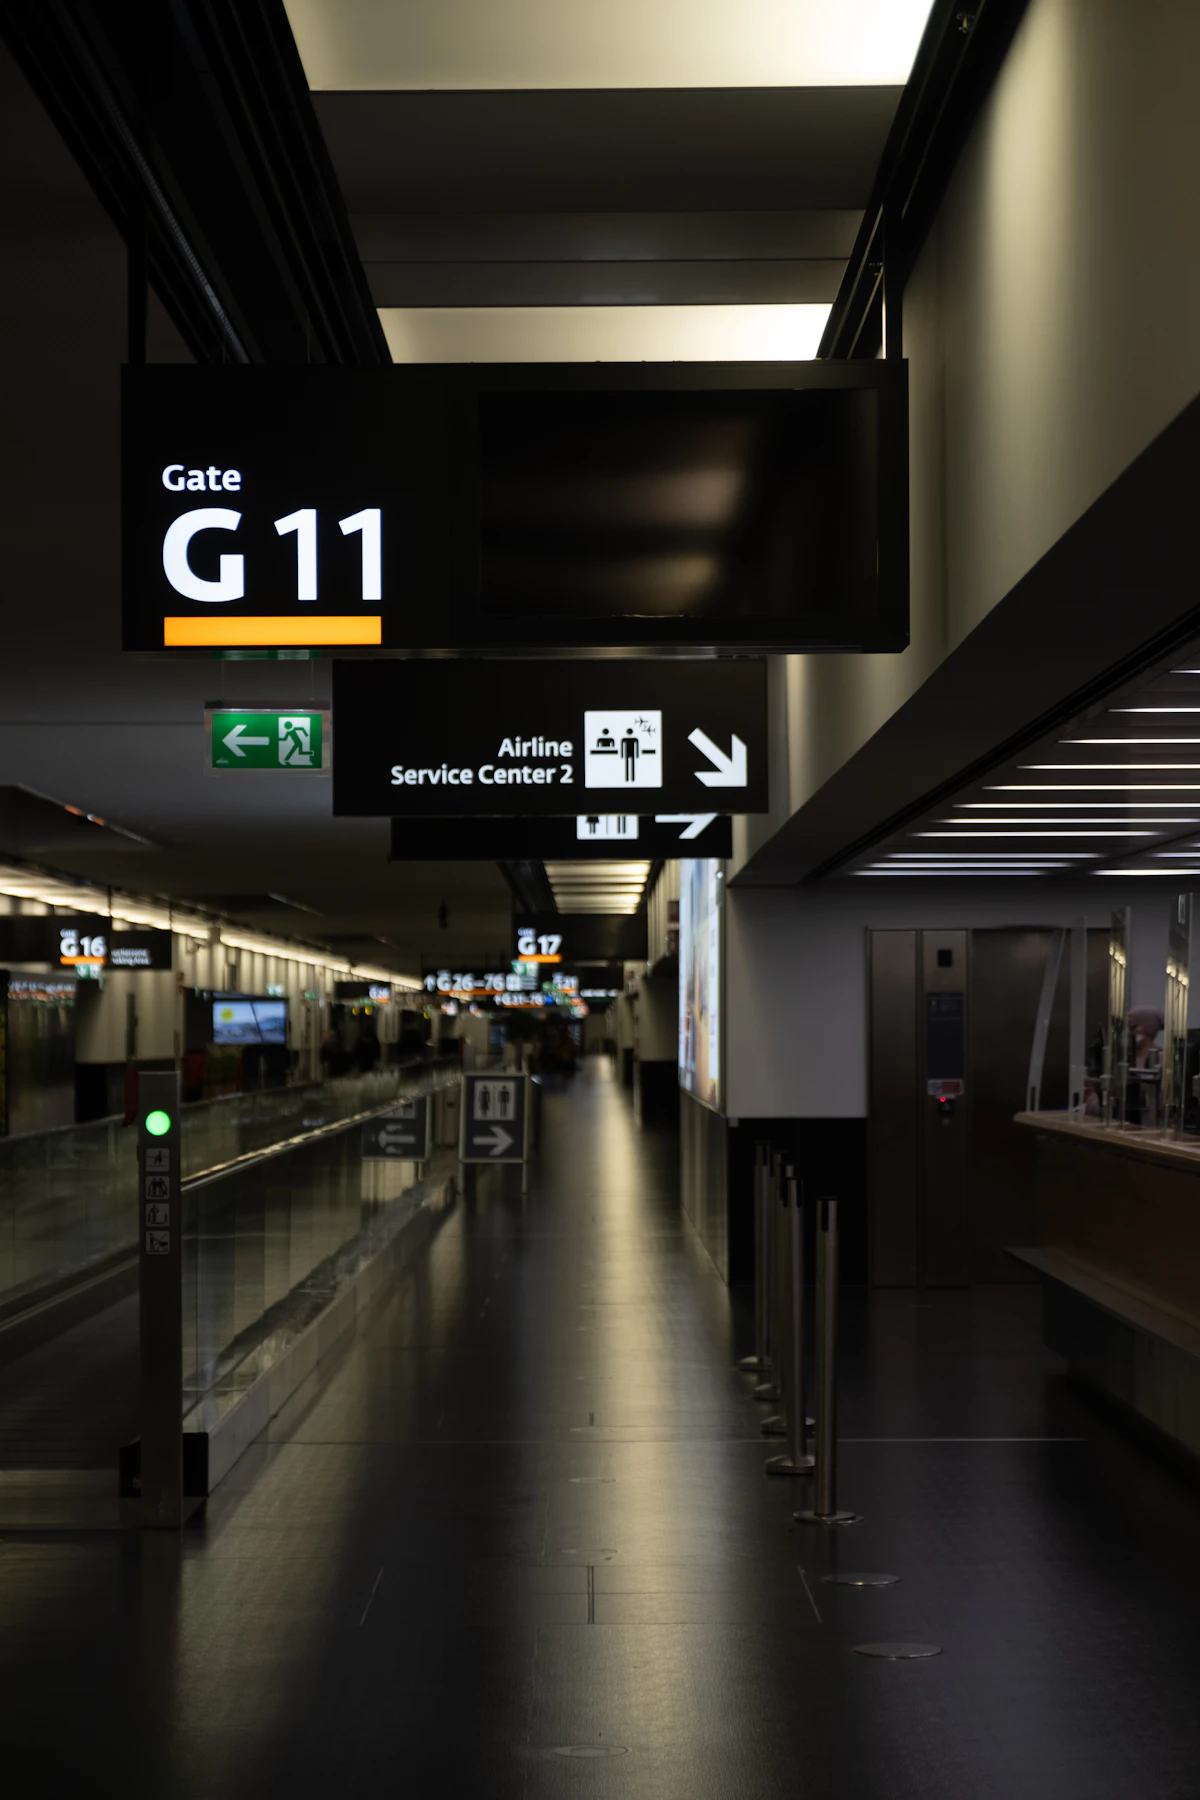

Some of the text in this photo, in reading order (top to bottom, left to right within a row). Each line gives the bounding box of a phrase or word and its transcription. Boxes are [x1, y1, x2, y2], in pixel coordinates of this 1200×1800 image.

[162, 464, 242, 491] Gate
[498, 736, 573, 757] Airline
[390, 763, 574, 785] Service Center 2
